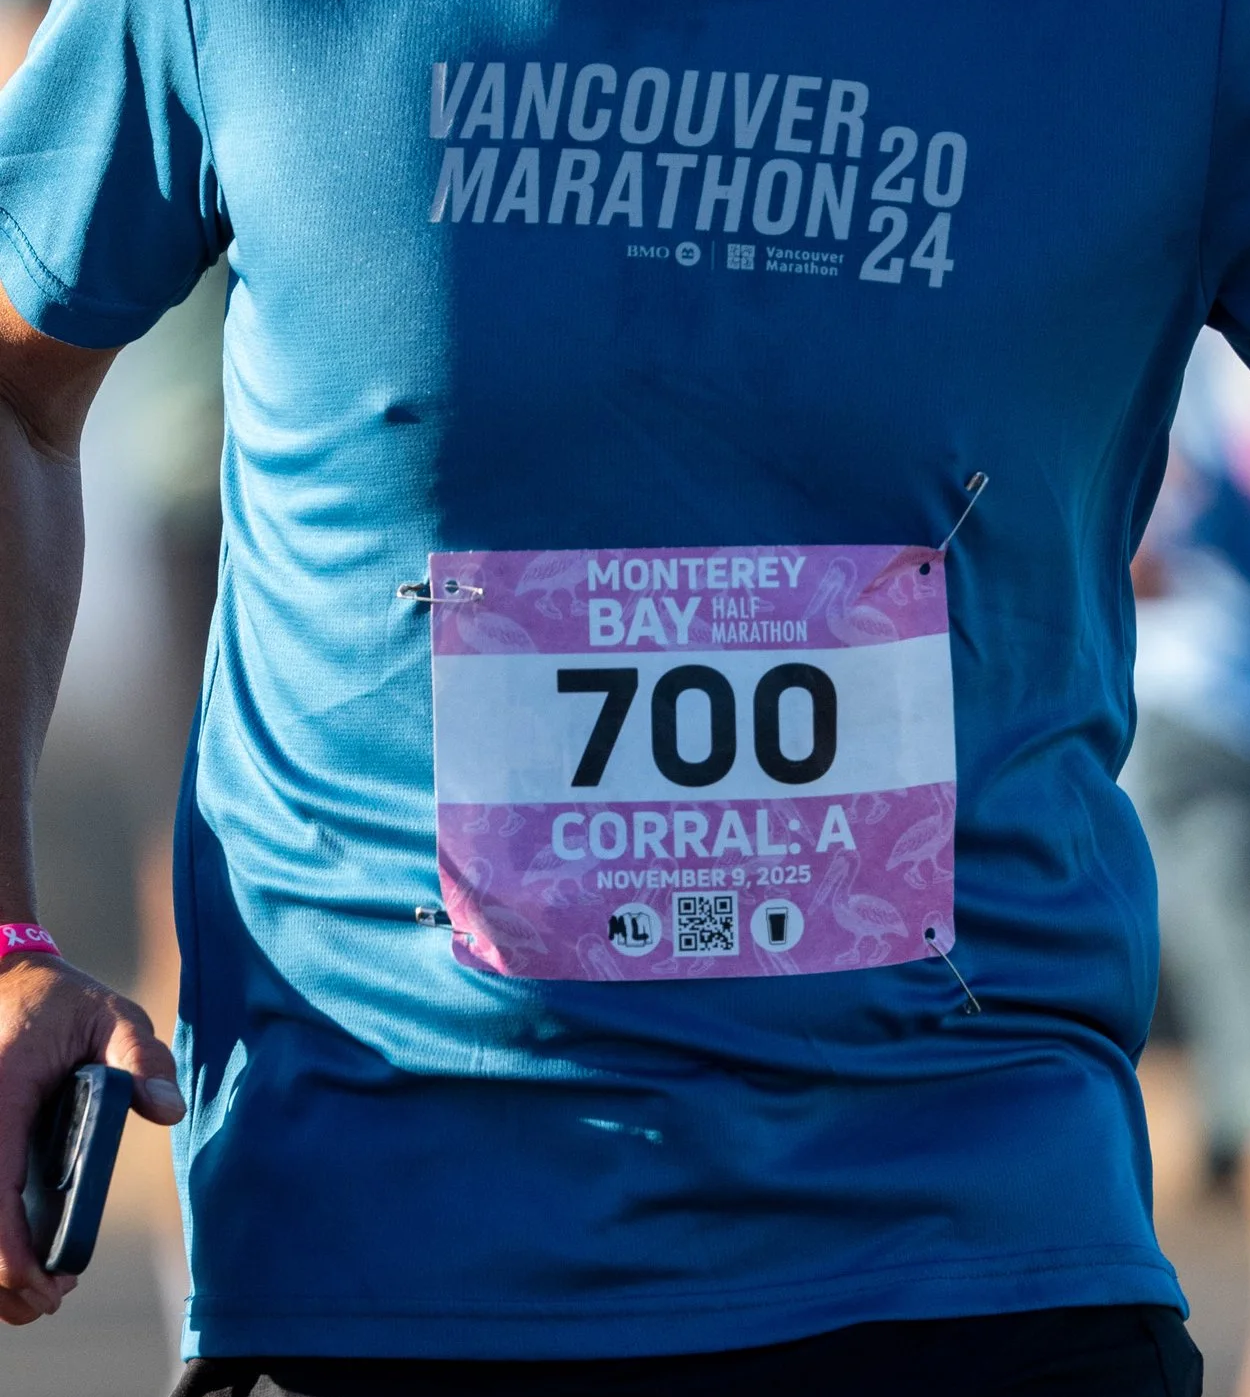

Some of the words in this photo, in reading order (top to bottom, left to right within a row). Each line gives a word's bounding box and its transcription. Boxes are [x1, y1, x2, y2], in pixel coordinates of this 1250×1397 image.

[429, 61, 870, 159] VANCOUVER
[870, 125, 968, 208] 20
[428, 146, 859, 241] MARATHON
[626, 244, 670, 259] BMO
[766, 246, 845, 264] Vancouver
[766, 260, 838, 277] Marathon
[858, 206, 955, 288] 24
[587, 556, 806, 592] MONTEREY
[588, 596, 702, 647] BAY
[711, 596, 761, 619] HALF
[711, 620, 808, 644] MARATHON
[556, 662, 838, 788] 700
[551, 810, 802, 861] CORRAL:
[816, 804, 857, 852] A
[597, 868, 726, 891] NOVEMBER
[731, 867, 754, 890] 9,
[757, 864, 812, 887] 2025
